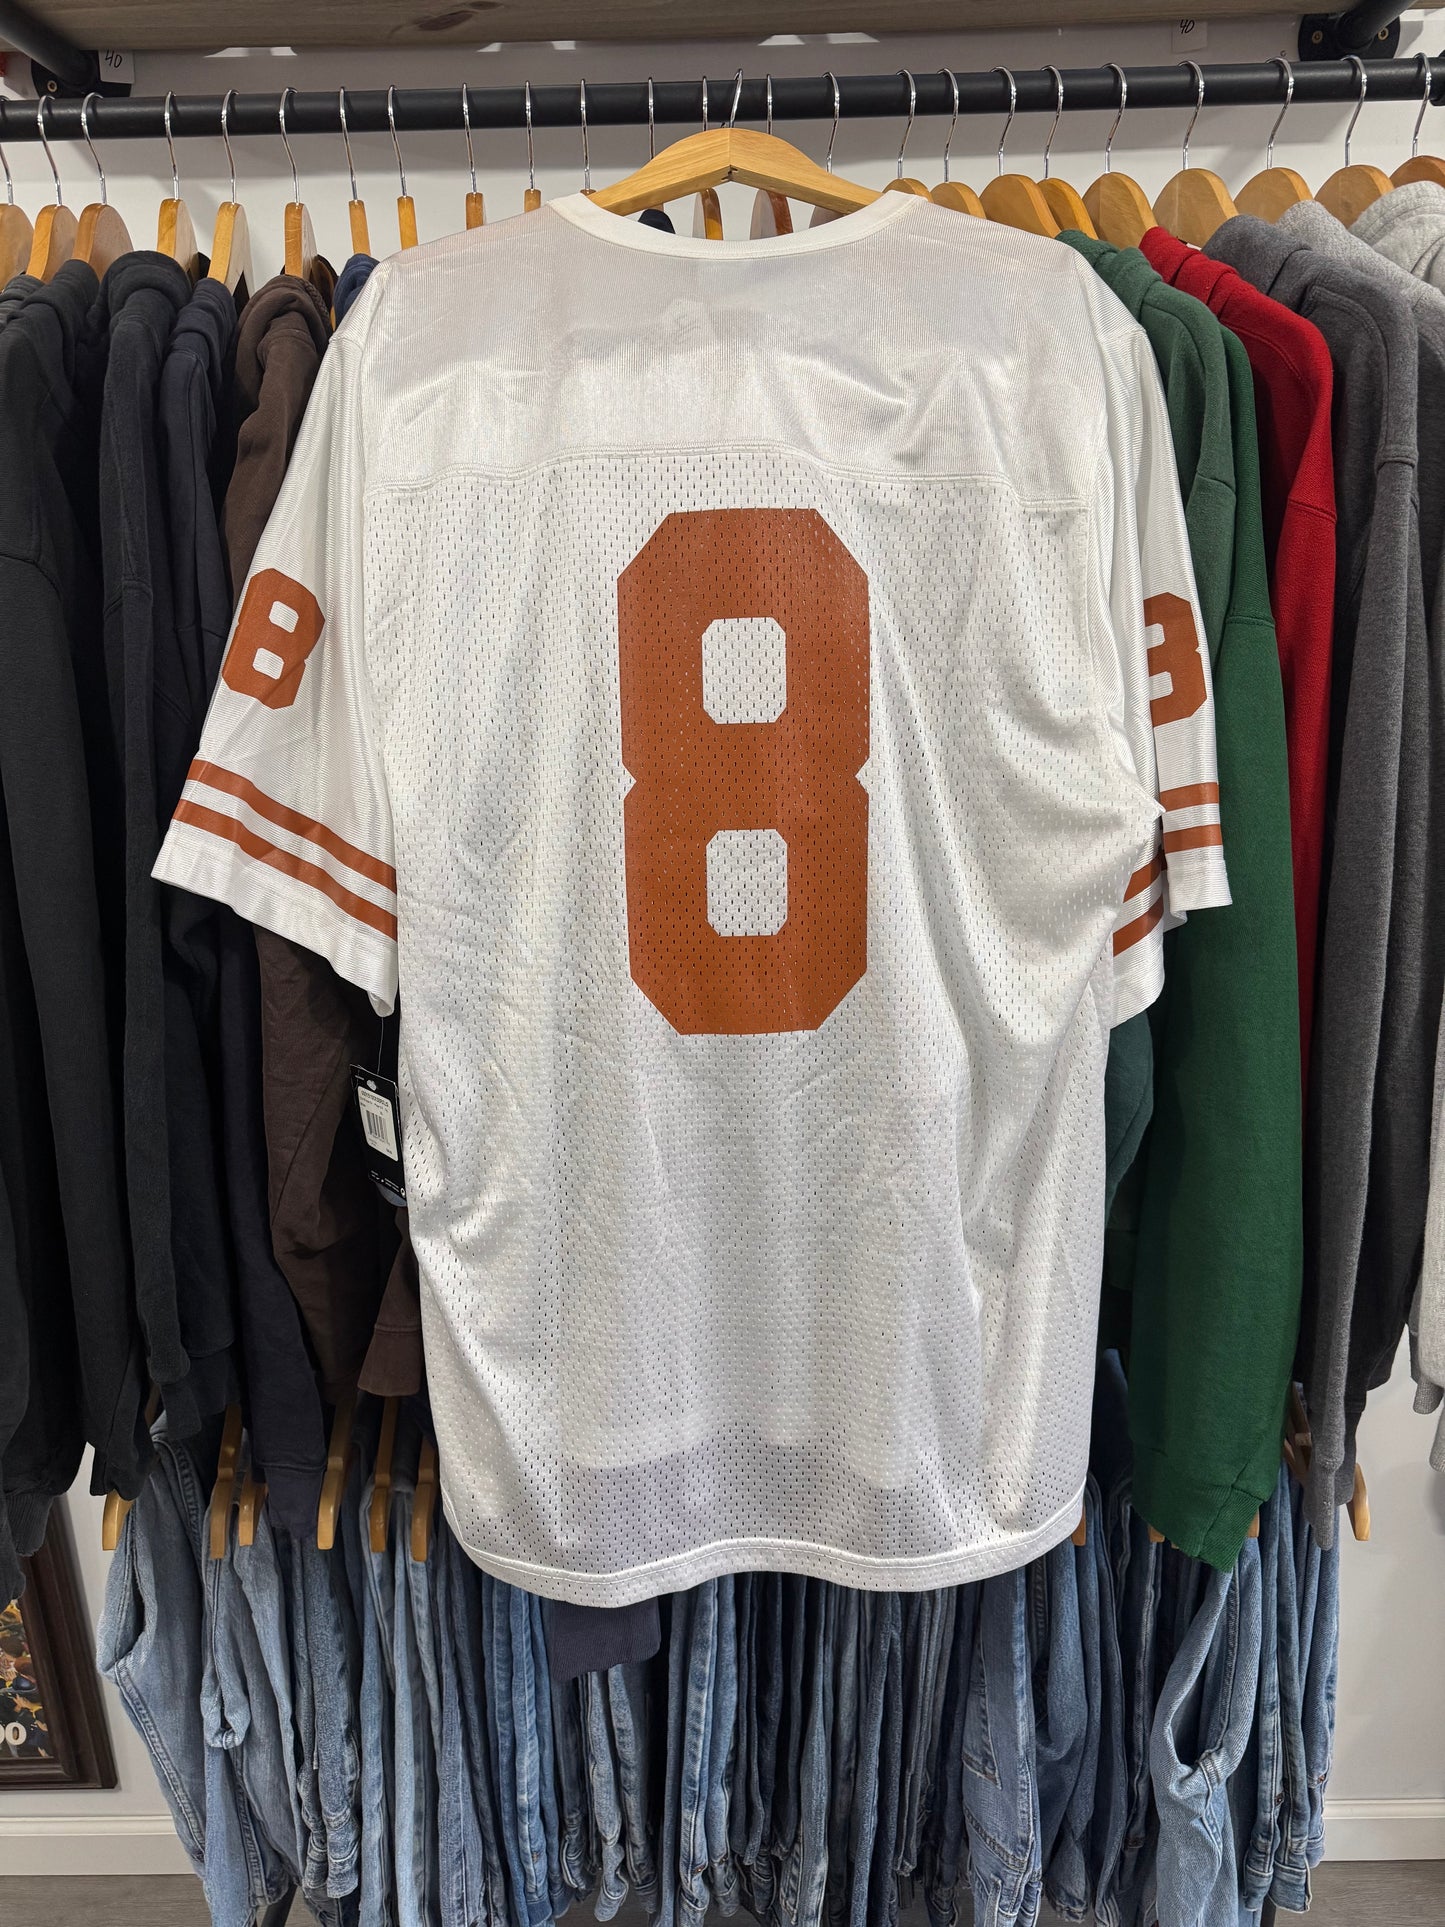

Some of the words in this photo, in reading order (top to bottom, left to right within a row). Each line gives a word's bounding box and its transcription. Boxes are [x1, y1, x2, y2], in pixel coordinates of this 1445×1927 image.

[1180, 19, 1195, 34] 40
[105, 49, 122, 68] 40
[222, 568, 325, 709] 8
[617, 508, 870, 1035] 8
[0, 1722, 27, 1745] 0
